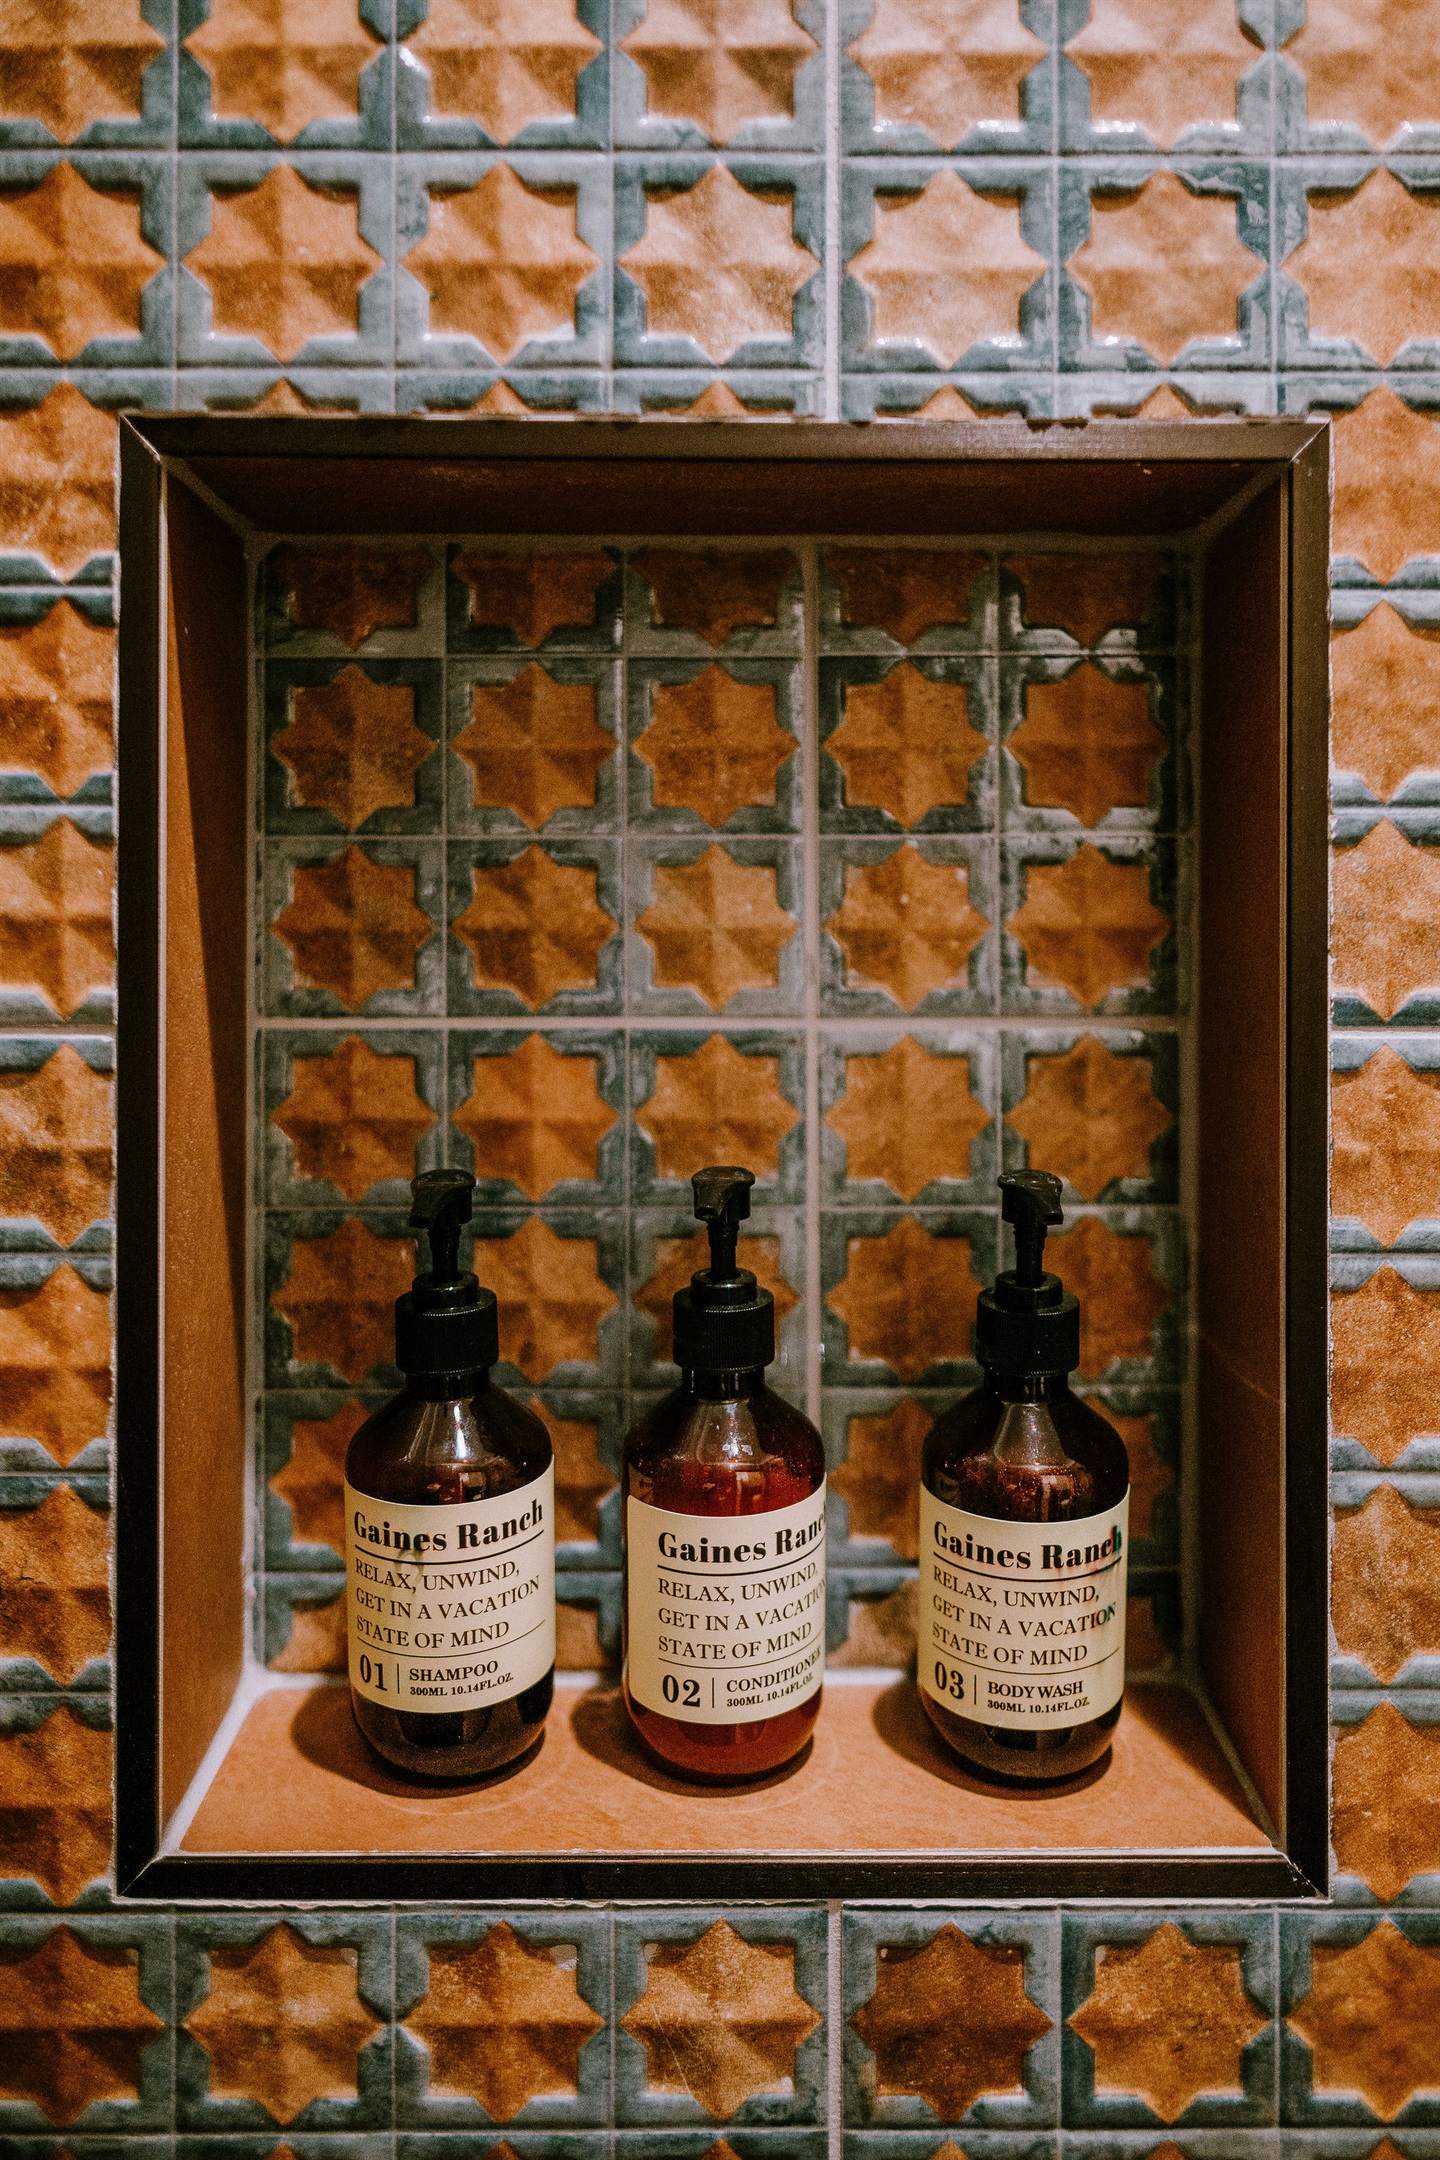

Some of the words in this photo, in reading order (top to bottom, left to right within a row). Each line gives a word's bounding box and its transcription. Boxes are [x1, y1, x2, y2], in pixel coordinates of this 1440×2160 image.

[354, 1512, 447, 1551] Gaines
[456, 1499, 543, 1549] Ranch
[658, 1532, 766, 1563] Gaines
[775, 1500, 826, 1556] Ranc
[934, 1521, 1031, 1569] Gaines
[1041, 1525, 1122, 1570] Ranch
[355, 1557, 416, 1594] RELAX,
[423, 1561, 520, 1591] UNWIND,
[658, 1577, 735, 1605] RELAX,
[741, 1562, 818, 1600] UNWIND,
[933, 1564, 997, 1608] RELAX,
[1004, 1585, 1100, 1608] UNWIND,
[356, 1587, 385, 1613] GET
[390, 1600, 411, 1618] IN
[417, 1604, 432, 1619] A
[438, 1575, 540, 1619] VACATION
[933, 1593, 964, 1623] GET
[970, 1611, 992, 1631] IN
[997, 1619, 1012, 1635] A
[1018, 1602, 1117, 1637] VACATION
[356, 1615, 409, 1646] STATE
[414, 1633, 444, 1648] OF
[450, 1621, 510, 1648] MIND
[658, 1607, 700, 1630] GET
[705, 1615, 729, 1631] IN
[735, 1614, 750, 1630] A
[658, 1635, 726, 1660] STATE
[731, 1641, 762, 1659] OF
[766, 1622, 812, 1654] MIND
[933, 1621, 988, 1660] STATE
[993, 1647, 1024, 1665] OF
[1030, 1644, 1088, 1666] MIND
[360, 1654, 388, 1691] 01
[409, 1660, 499, 1682] SHAMPOO
[410, 1686, 448, 1696] 300ML
[662, 1674, 701, 1708] 02
[935, 1661, 965, 1699] 03
[987, 1680, 1036, 1699] BODY
[1036, 1680, 1084, 1699] WASH
[726, 1695, 764, 1708] 300ML
[987, 1699, 1026, 1713] 300ML
